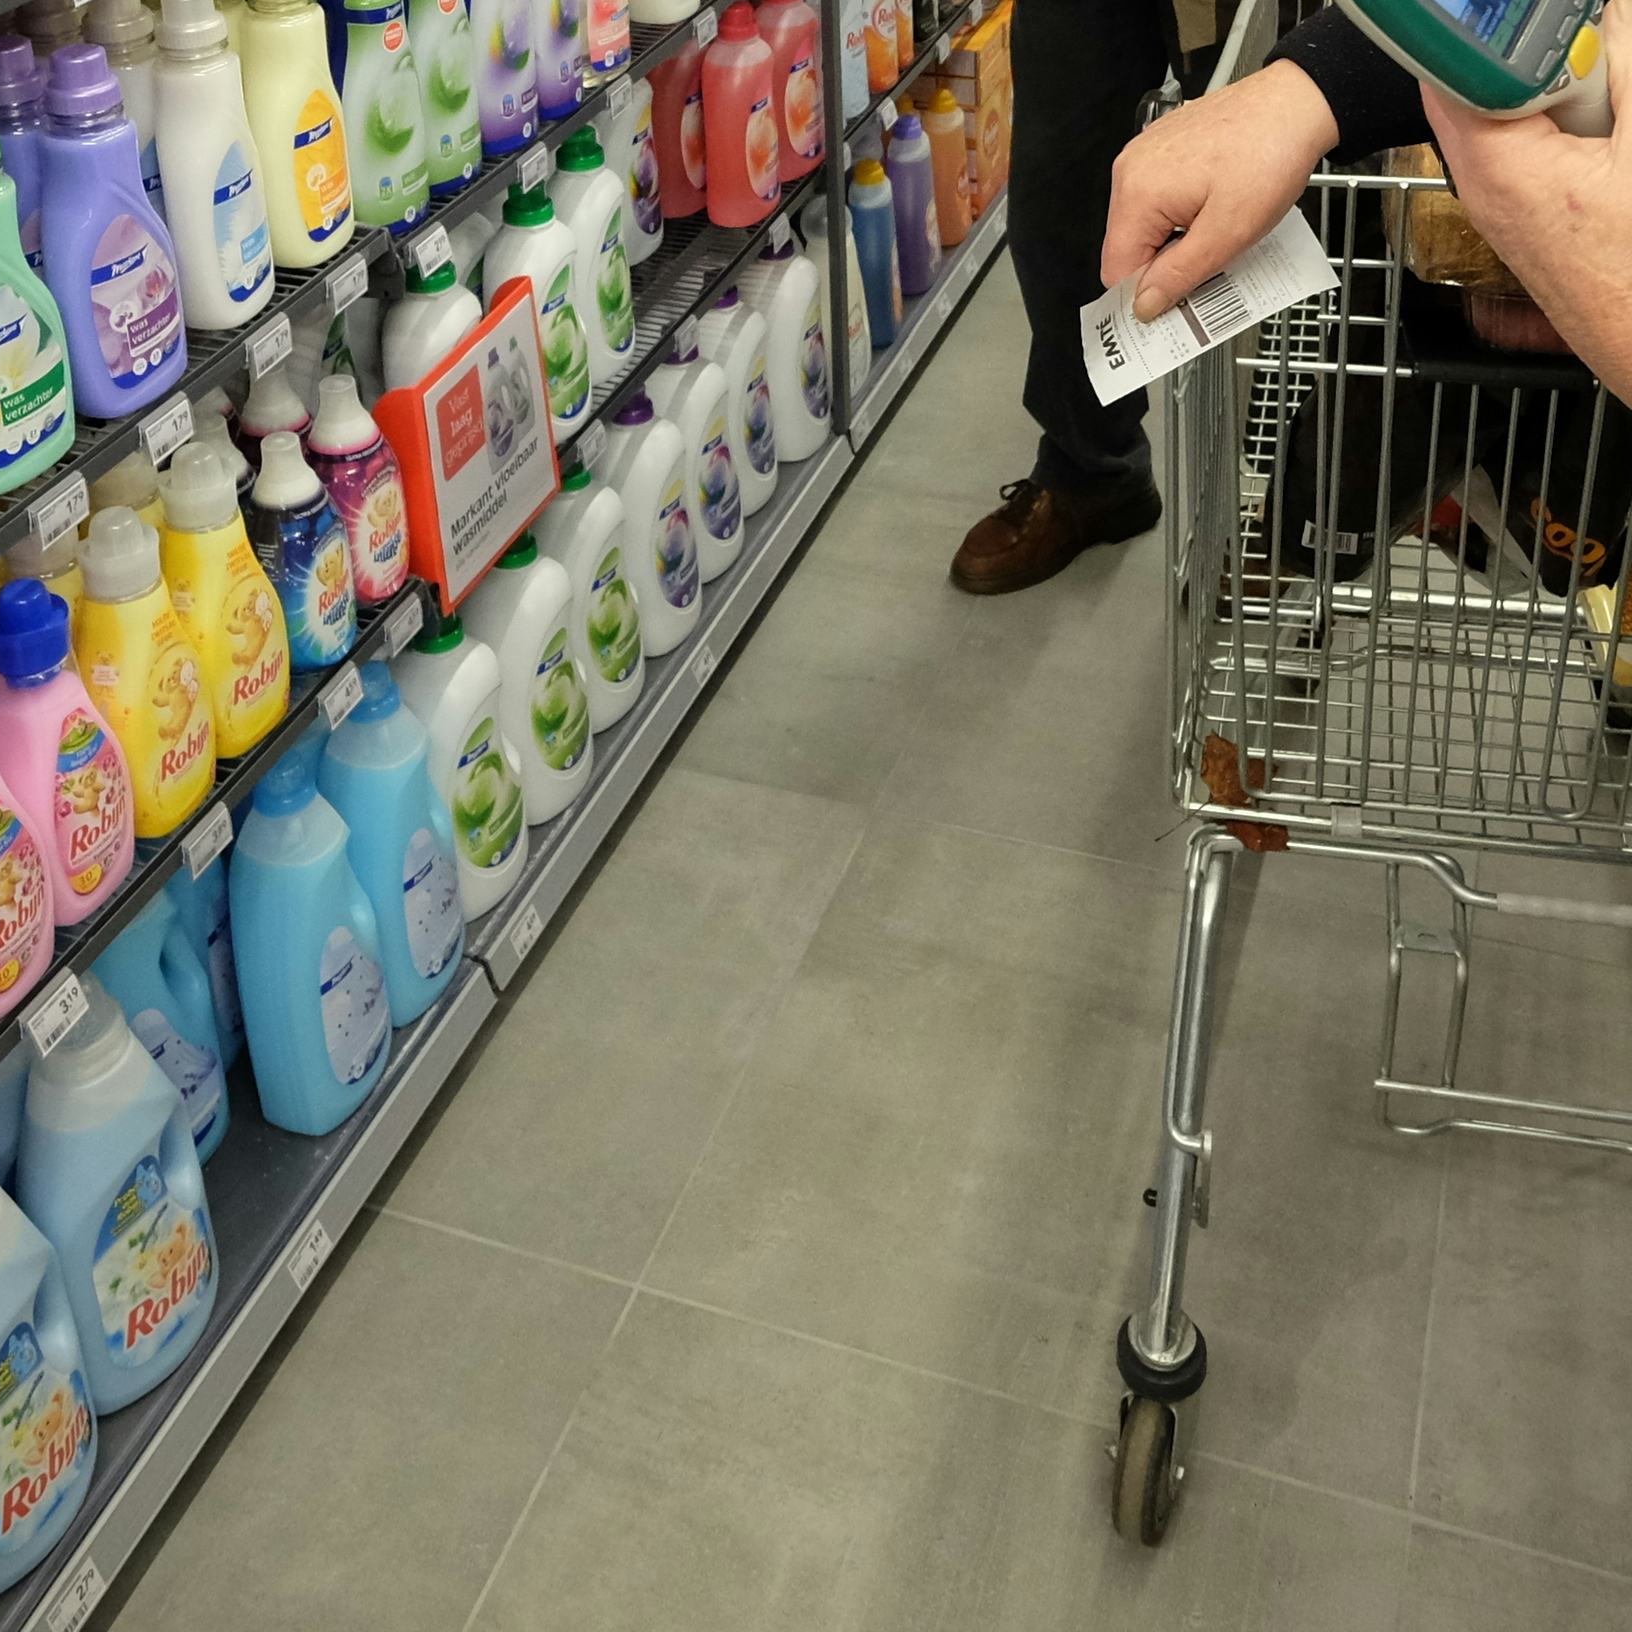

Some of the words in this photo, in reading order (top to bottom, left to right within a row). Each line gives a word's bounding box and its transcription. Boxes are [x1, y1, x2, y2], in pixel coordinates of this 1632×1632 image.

[1096, 314, 1125, 370] EMTÉ
[451, 483, 494, 539] Markant
[495, 437, 538, 491] vloeibaar
[453, 490, 507, 555] wasmiddel
[160, 721, 209, 781] Robijn
[70, 795, 126, 862] Robijn
[124, 1242, 210, 1350] Robijn
[0, 1404, 87, 1536] Robijn
